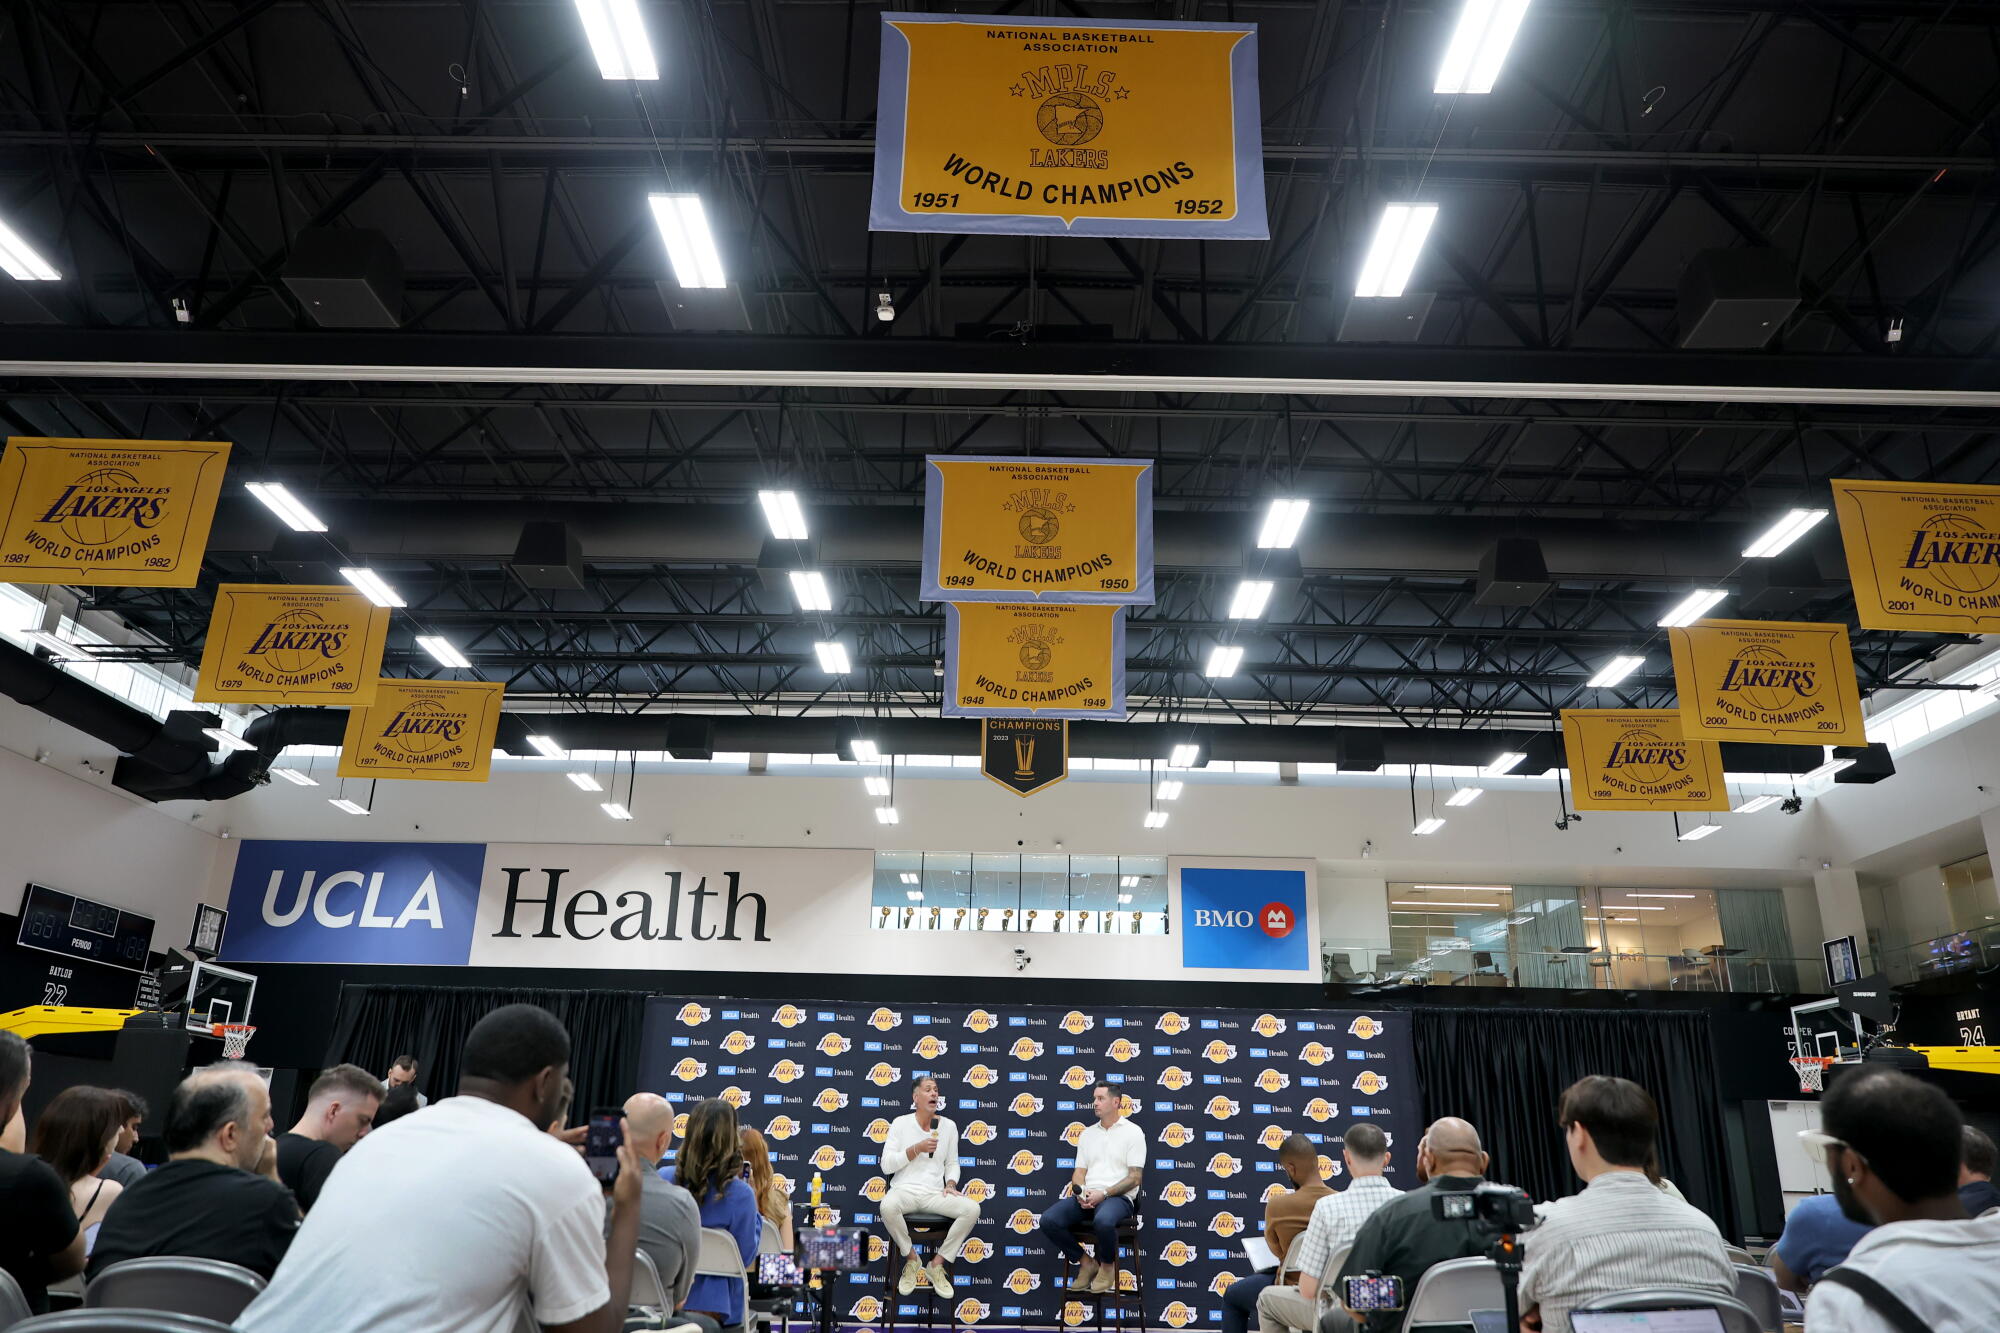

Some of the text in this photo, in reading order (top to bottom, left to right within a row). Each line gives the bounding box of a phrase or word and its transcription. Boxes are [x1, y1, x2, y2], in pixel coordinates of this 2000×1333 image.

[986, 29, 1155, 44] NATIONAL BASKETBALL
[1023, 42, 1119, 54] ASSOCIATION
[1021, 63, 1116, 103] MPLS.
[1030, 148, 1108, 169] LAKERS
[943, 152, 1194, 205] WORLD CHAMPIONS
[913, 192, 960, 208] 1951
[1174, 199, 1223, 215] 1952
[989, 465, 1091, 474] NATIONAL BASKETBALL
[85, 486, 171, 495] LOS ANGELES
[33, 485, 169, 529] LAKERS
[1009, 487, 1068, 514] MPLS.
[1923, 504, 1977, 512] ASSOCIATION
[1935, 530, 2000, 540] LOS ANGE
[24, 529, 161, 562] WORLD CHAMPIONS
[1014, 545, 1062, 559] LAKERS
[3, 553, 30, 564] 1981
[143, 557, 171, 568] 1982
[963, 549, 1113, 584] WORLD CHAMPIONS
[945, 575, 975, 586] 1949
[1099, 578, 1129, 589] 1950
[1900, 576, 1953, 607] WORLD
[1888, 600, 1915, 611] 2001
[243, 623, 347, 659] LAKERS
[1767, 660, 1816, 669] ANGELES
[236, 660, 344, 686] WORLD CHAMPIONS
[1717, 659, 1816, 697] LAKERS
[220, 680, 243, 688] 1979
[330, 682, 353, 690] 1980
[975, 674, 1093, 702] WORLD CHAMPIONS
[962, 696, 985, 705] 1948
[1083, 698, 1106, 707] 1949
[1716, 697, 1825, 724] WORLD CHAMPIONS
[378, 711, 467, 742] LAKERS
[989, 720, 1061, 731] CHAMPIONS
[1705, 716, 1728, 725] 2000
[1817, 721, 1838, 730] 2001
[373, 741, 463, 764] WORLD CHAMPIONS
[1602, 742, 1687, 771] LAKERS
[451, 761, 470, 769] 1972
[1602, 773, 1694, 795] WORLD CHAMPIONS
[1593, 790, 1612, 798] 1999
[261, 867, 772, 942] UCLA Health
[1194, 909, 1254, 928] BMO
[71, 938, 92, 950] PERIOD
[49, 965, 73, 979] BAYLOR
[41, 982, 68, 1006] 22
[677, 1008, 710, 1021] LAKERS
[741, 1011, 760, 1019] Health
[773, 1009, 805, 1023] LAKERS
[817, 1013, 856, 1022] UCLA Health
[868, 1013, 901, 1026] LAKERS
[932, 1016, 951, 1024] Health
[1956, 1008, 1980, 1021] BRYANT
[965, 1015, 997, 1028] LAKERS
[1011, 1018, 1047, 1026] UCLA Health
[1060, 1016, 1093, 1029] LAKERS
[1124, 1019, 1143, 1027] Health
[1157, 1017, 1189, 1030] LAKERS
[1220, 1021, 1240, 1029] Health
[1253, 1019, 1285, 1032] LAKERS
[1316, 1023, 1336, 1031] Health
[1349, 1021, 1382, 1034] LAKERS
[1960, 1025, 1986, 1047] 24
[818, 1038, 851, 1051] LAKERS
[962, 1045, 999, 1053] UCLA Health
[1011, 1043, 1043, 1056] LAKERS
[1155, 1047, 1192, 1055] UCLA Health
[1203, 1045, 1236, 1059] LAKERS
[770, 1065, 803, 1078] LAKERS
[817, 1068, 854, 1077] UCLA Health
[964, 1070, 997, 1083] LAKERS
[1159, 1072, 1191, 1085] LAKERS
[1205, 1076, 1242, 1084] UCLA Health
[1255, 1105, 1293, 1113] UCLA Health
[1028, 1129, 1047, 1137] Health
[1008, 1155, 1042, 1170] LAKERS
[1161, 1187, 1195, 1201] LAKERS
[1209, 1191, 1248, 1199] UCLA Health
[1177, 1220, 1197, 1228] Health
[1026, 1247, 1046, 1255] Health
[953, 1302, 989, 1318] LAKERS
[1023, 1308, 1043, 1316] Health
